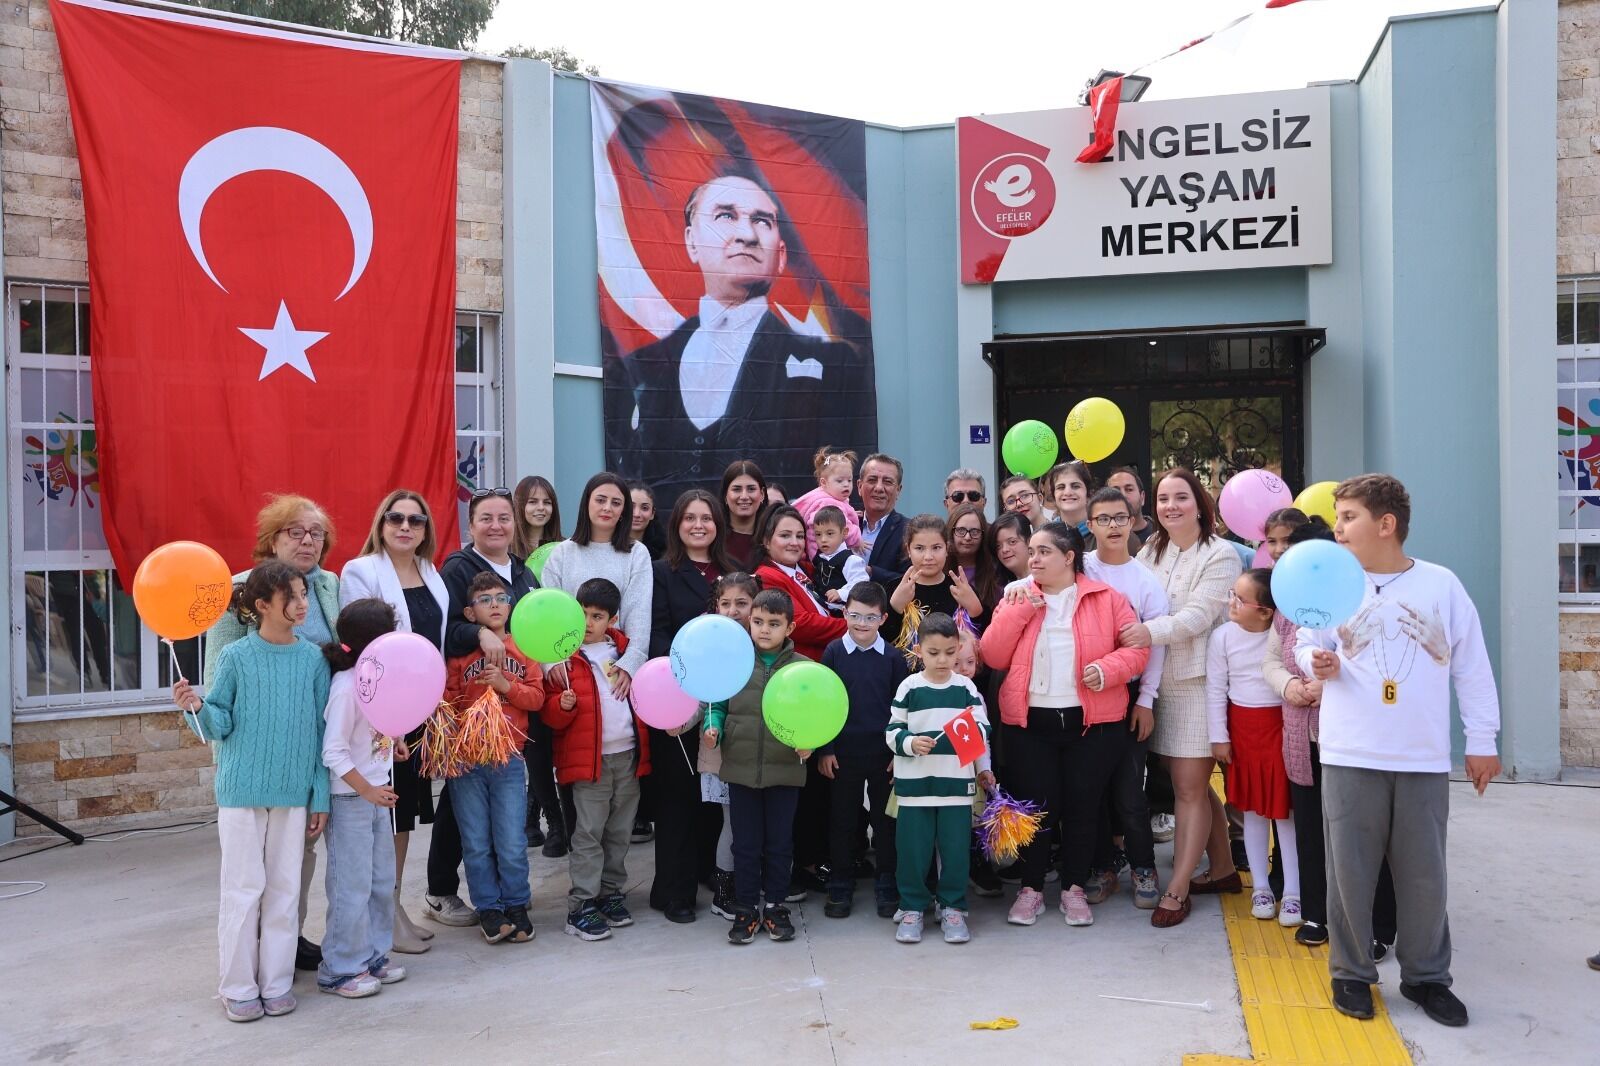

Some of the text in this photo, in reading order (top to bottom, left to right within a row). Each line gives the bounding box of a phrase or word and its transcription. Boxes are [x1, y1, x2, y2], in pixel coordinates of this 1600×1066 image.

[1119, 166, 1276, 213] YAŞAM
[996, 211, 1032, 223] EFELER
[1100, 205, 1300, 258] MERKEZİ
[977, 427, 983, 437] 4
[1384, 684, 1395, 701] G
